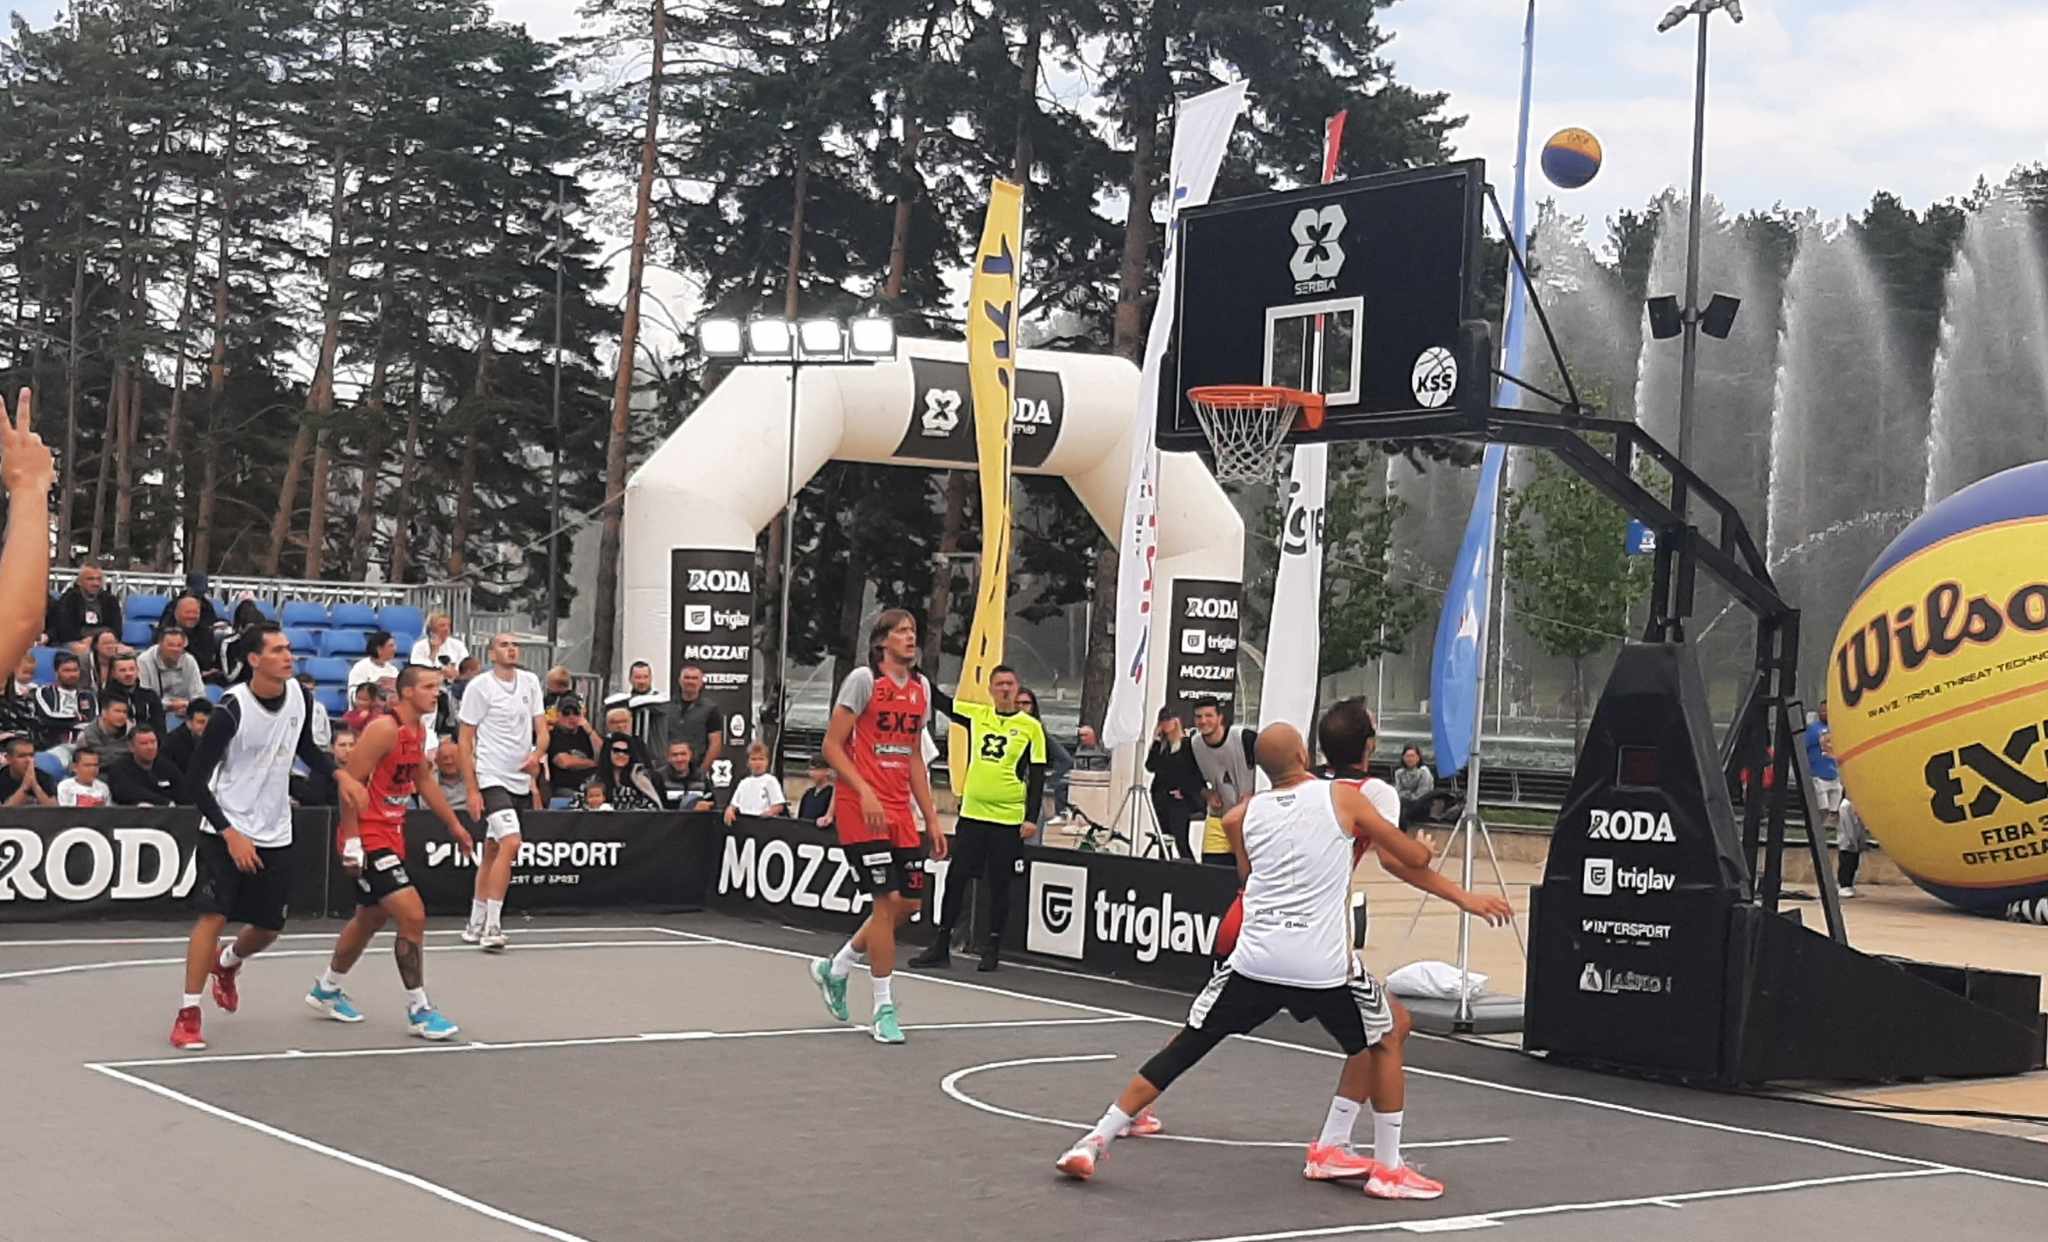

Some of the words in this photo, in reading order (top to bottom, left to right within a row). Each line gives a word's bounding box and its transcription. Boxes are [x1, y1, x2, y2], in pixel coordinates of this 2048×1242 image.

[1295, 279, 1336, 296] SERBIA
[1416, 373, 1452, 393] KSS
[687, 569, 751, 593] RODA
[1185, 597, 1239, 620] RODA
[684, 644, 750, 661] MOZZART
[1943, 667, 1993, 690] THREAT
[1587, 809, 1677, 842] RODA
[1981, 822, 2036, 846] FIBA
[1617, 867, 1675, 895] triglav
[1094, 889, 1220, 962] triglav
